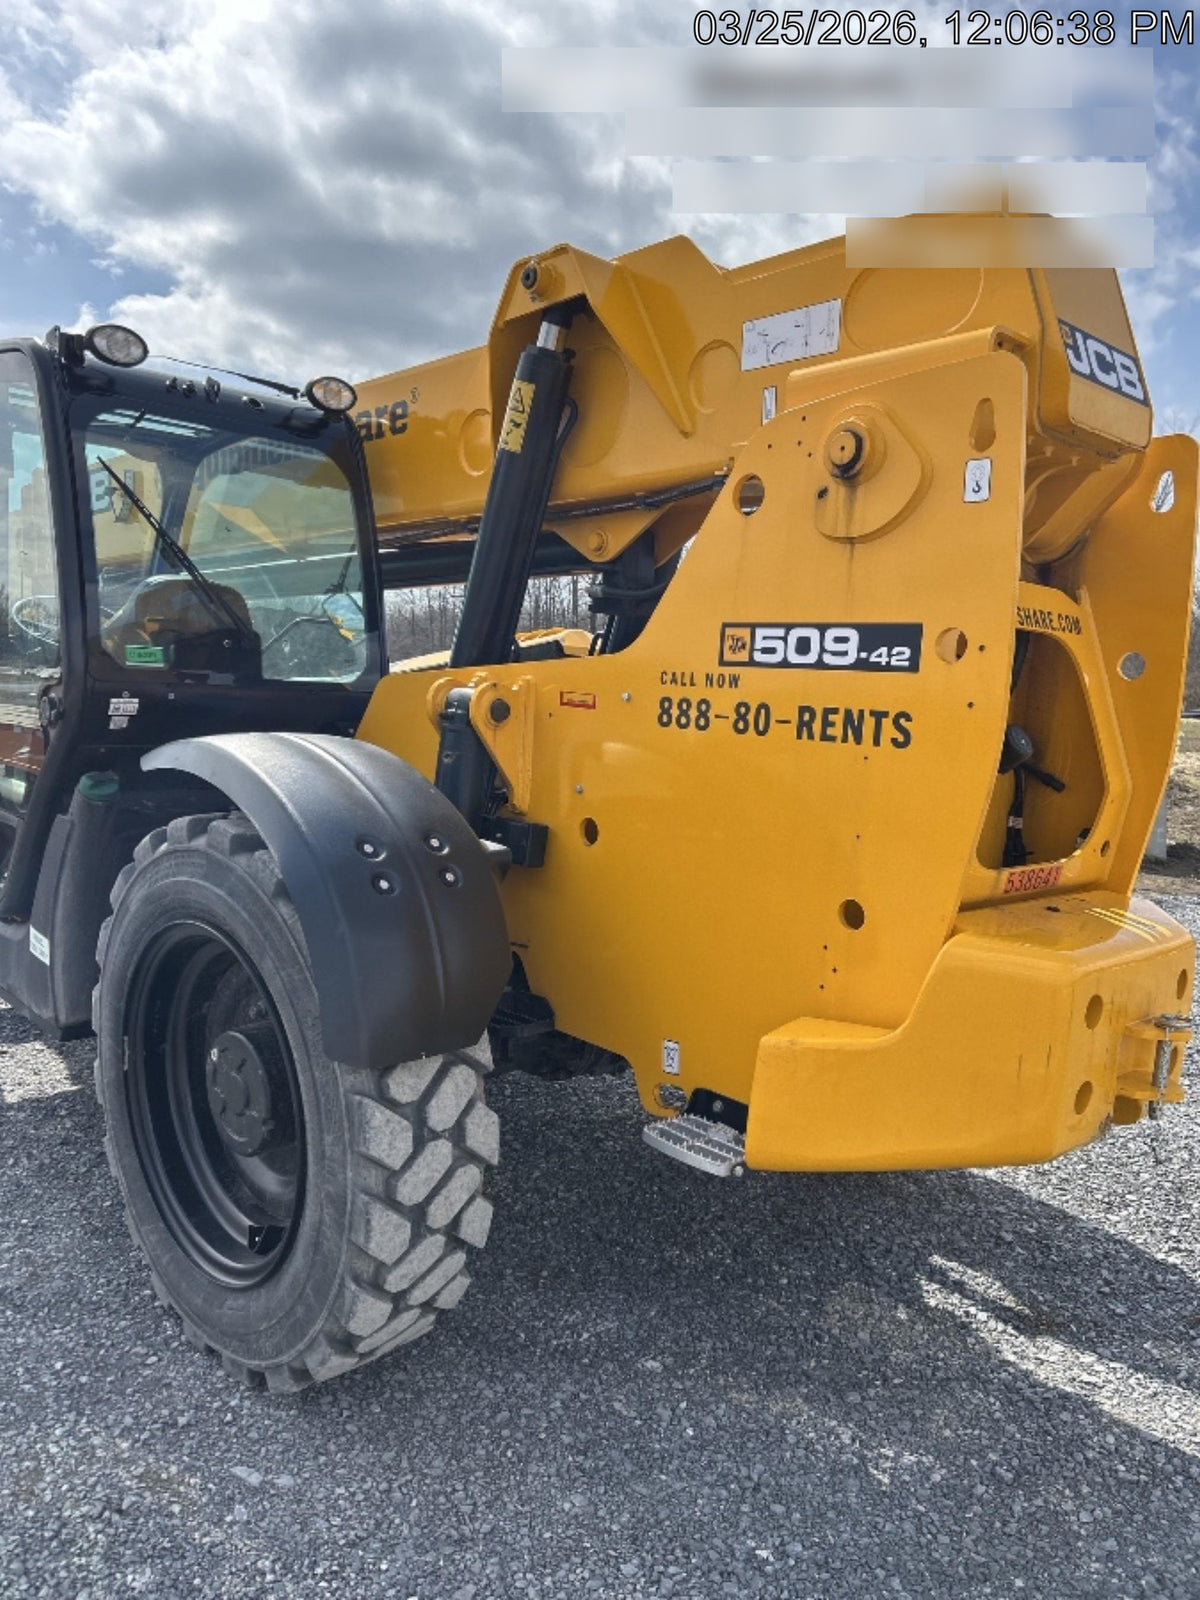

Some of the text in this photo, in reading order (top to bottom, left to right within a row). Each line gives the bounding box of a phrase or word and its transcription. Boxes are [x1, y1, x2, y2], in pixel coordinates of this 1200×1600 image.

[1066, 331, 1145, 402] JCB
[751, 626, 912, 668] 509-42
[660, 670, 741, 690] CALL NOW
[657, 695, 914, 750] 888-80-RENTS
